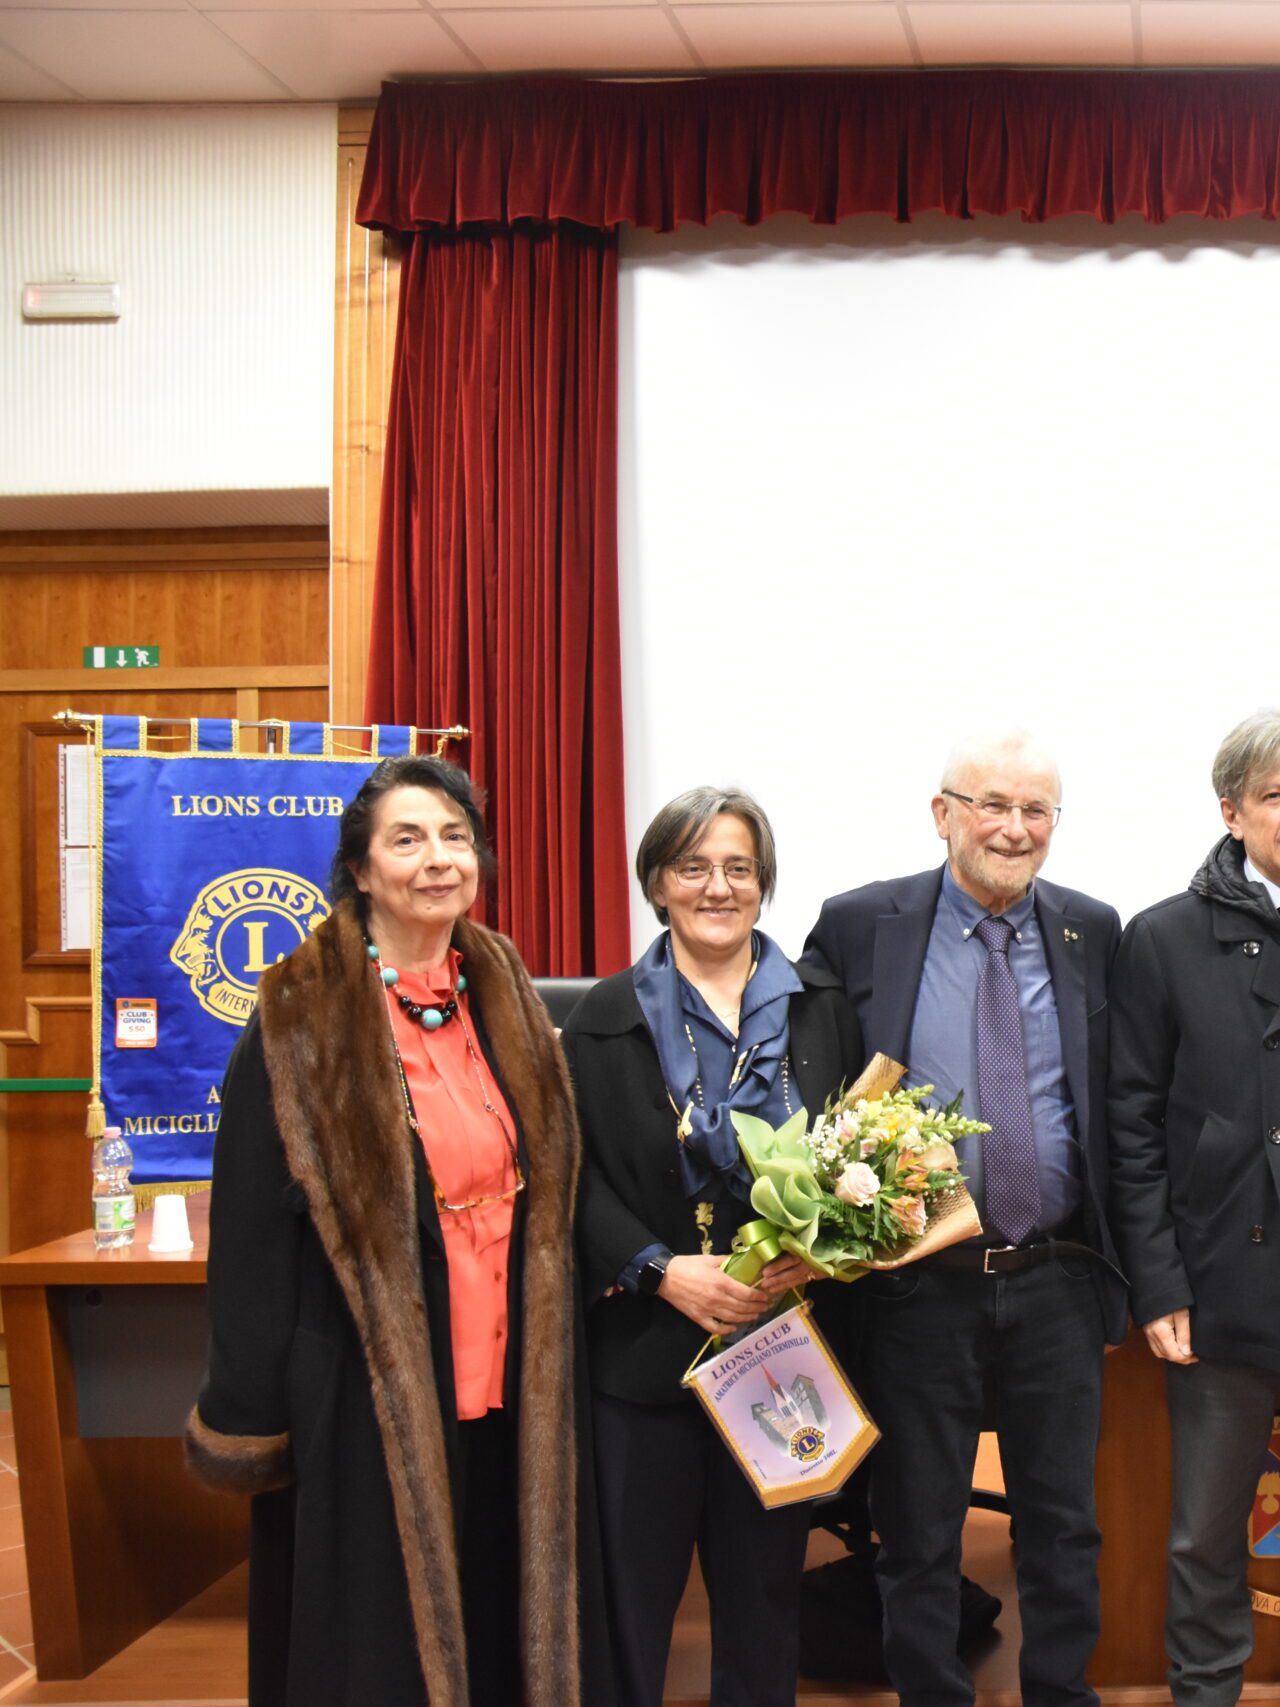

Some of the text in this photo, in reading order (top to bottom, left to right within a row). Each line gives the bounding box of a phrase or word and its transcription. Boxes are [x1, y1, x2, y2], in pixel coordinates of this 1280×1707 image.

[171, 795, 344, 817] LIONS CLUB
[211, 880, 308, 912] LIONS
[124, 1113, 222, 1136] MICIGLI
[711, 1322, 792, 1381] LIONS CLUB
[714, 1335, 810, 1403] AMATRICE MICIGLIANO TERMINILLO
[801, 1438, 815, 1452] L
